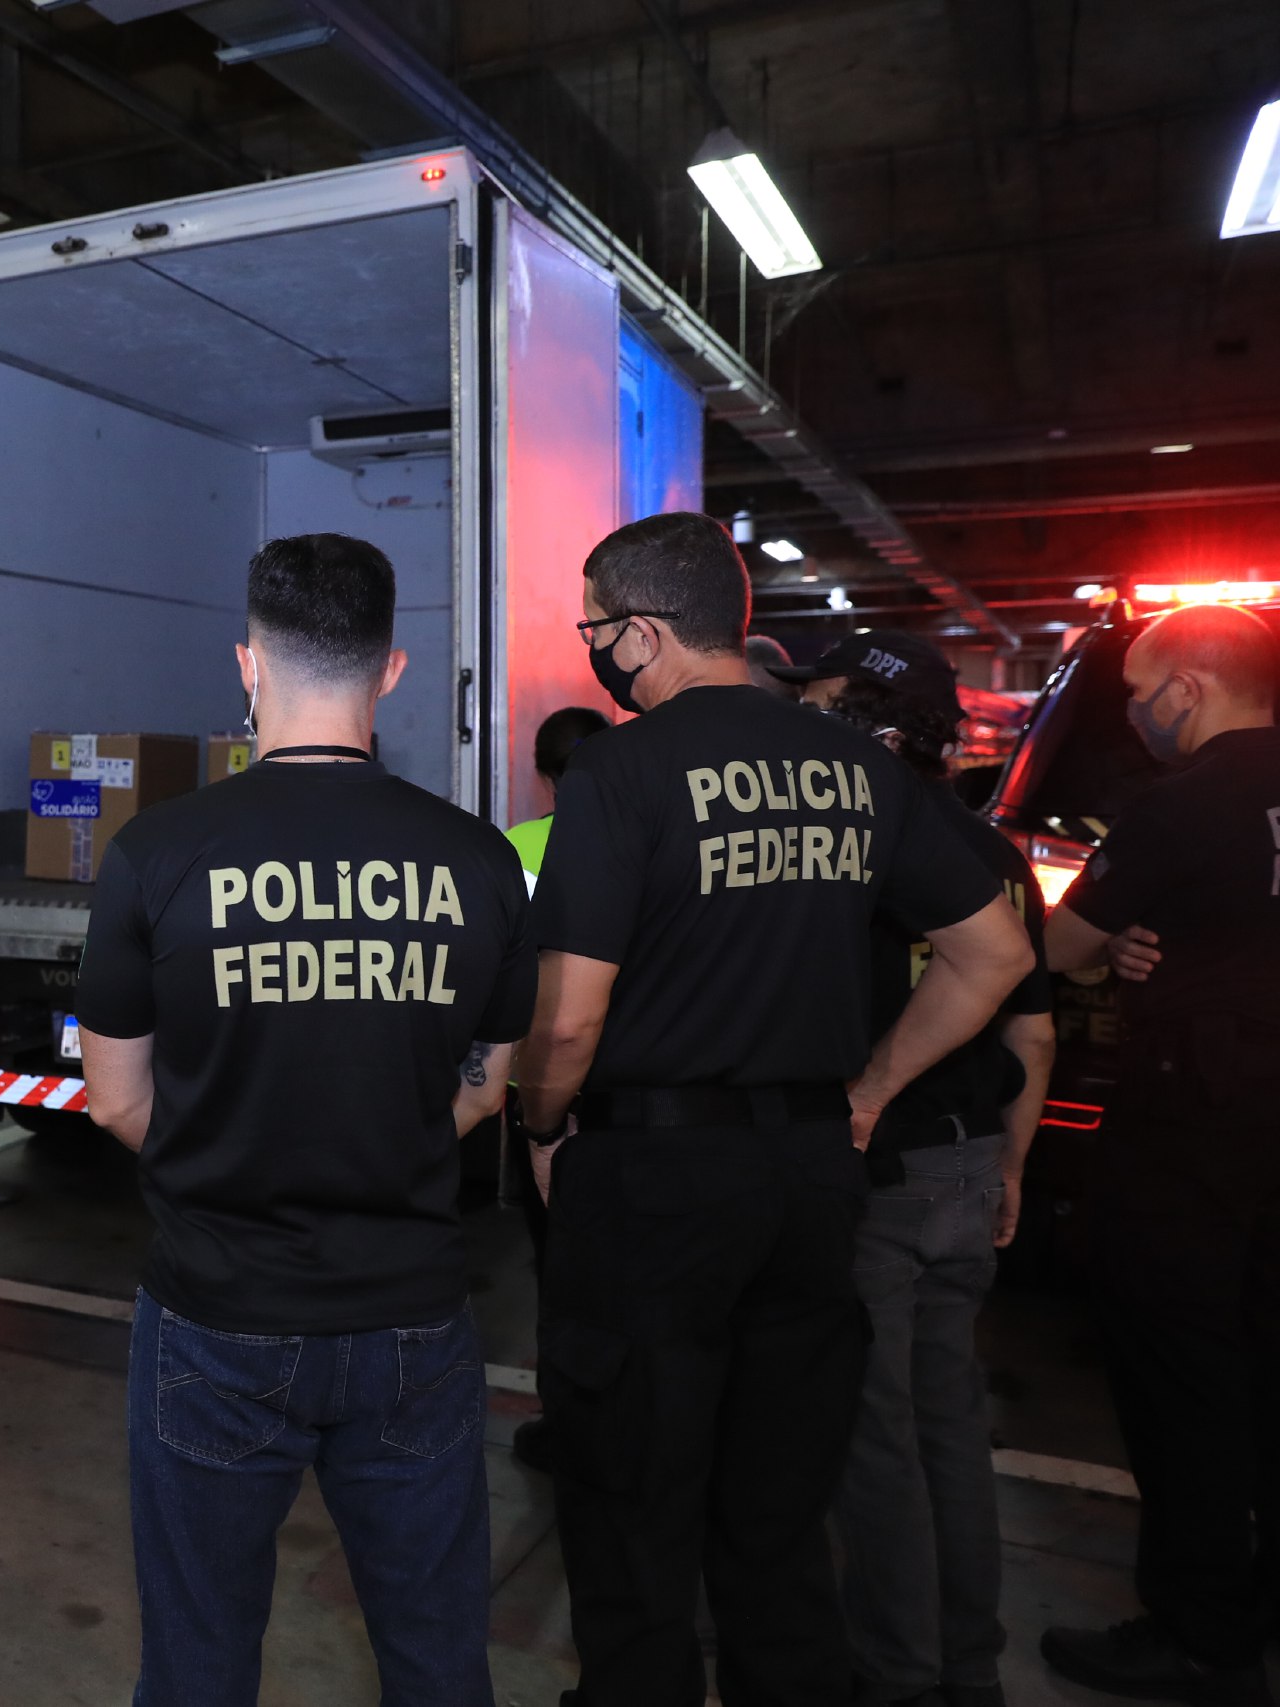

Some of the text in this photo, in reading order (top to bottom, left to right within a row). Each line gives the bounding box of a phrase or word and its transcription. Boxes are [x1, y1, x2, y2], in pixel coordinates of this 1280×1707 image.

[859, 648, 909, 679] DPF
[58, 751, 64, 760] 1
[40, 802, 98, 816] SOLIDÁRIO
[686, 759, 875, 823] POLÍCIA
[699, 825, 873, 895] FEDERAL
[209, 860, 465, 928] POLÍCIA
[212, 939, 457, 1008] FEDERAL
